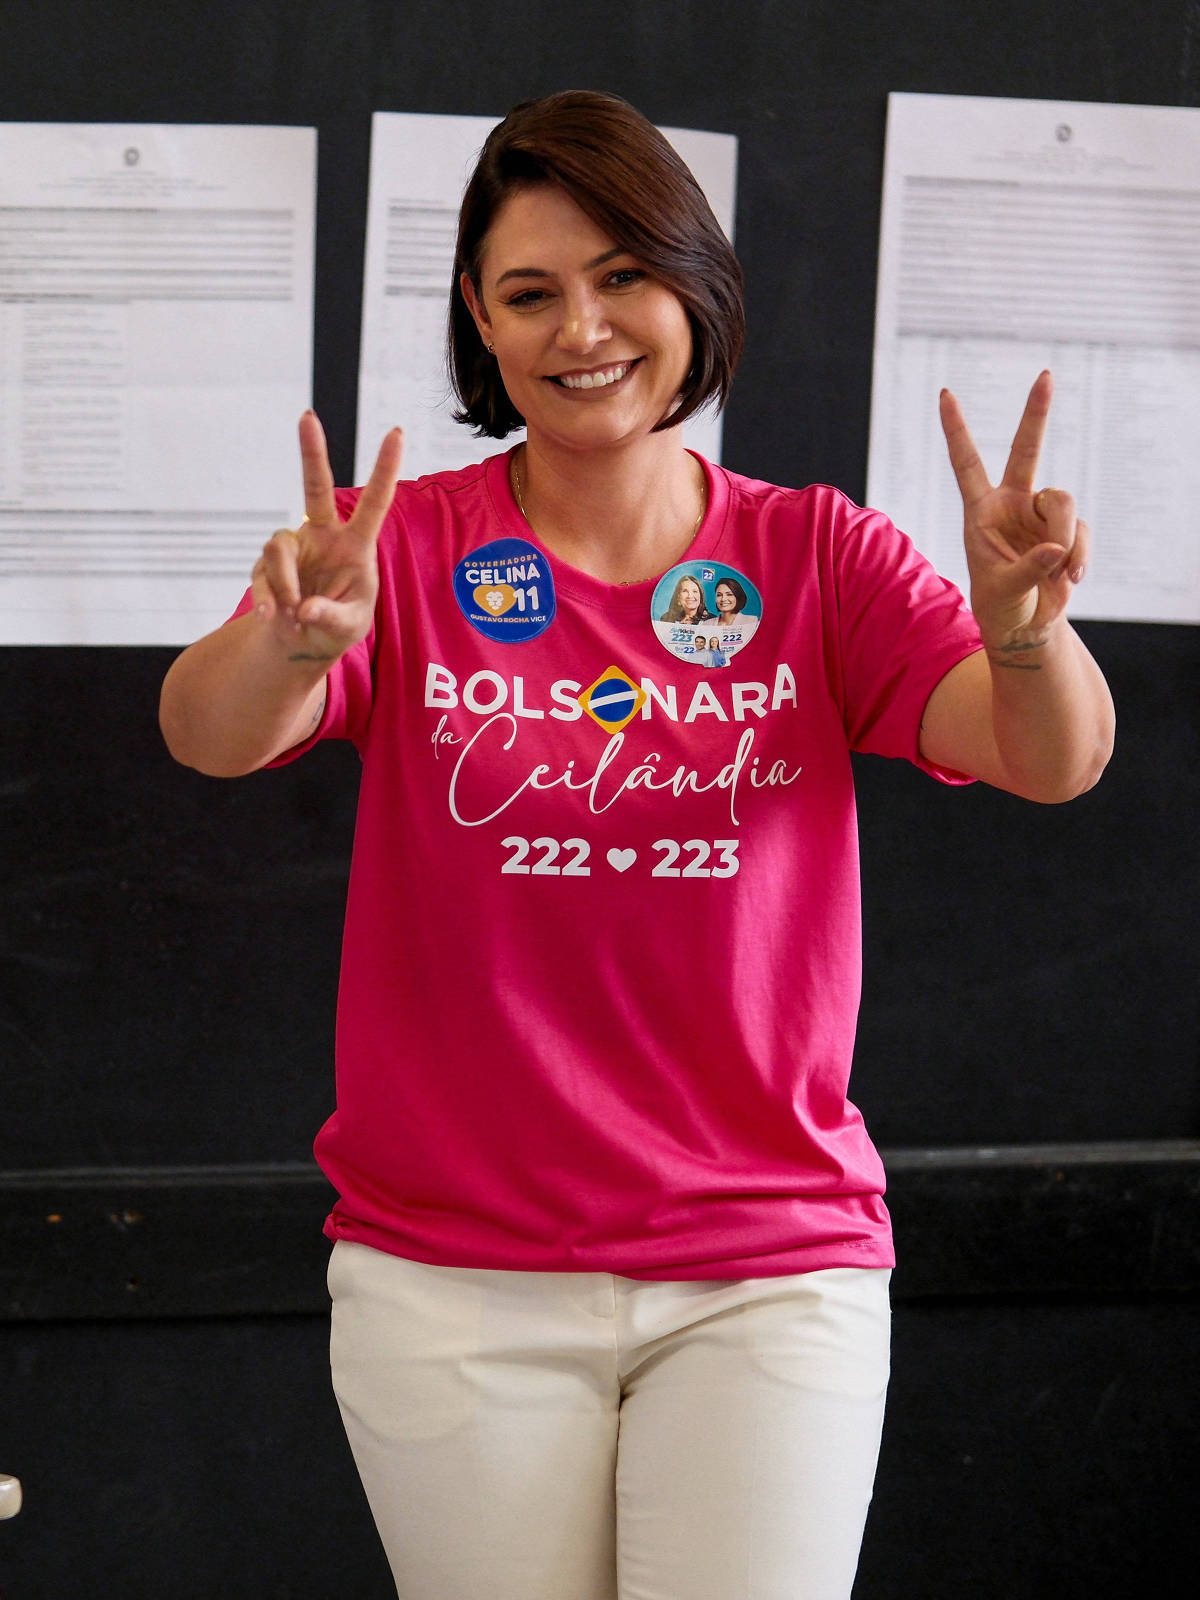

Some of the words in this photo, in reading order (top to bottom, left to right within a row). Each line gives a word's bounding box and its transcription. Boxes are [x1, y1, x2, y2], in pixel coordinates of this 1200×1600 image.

[465, 554, 538, 567] GOVERNADORA
[465, 563, 540, 585] CELINA
[513, 586, 539, 612] 11
[530, 615, 546, 623] VICE
[672, 633, 692, 642] 223
[431, 714, 463, 759] da
[448, 713, 802, 826] Ceilândia
[501, 836, 591, 877] 222
[651, 839, 740, 878] 223
